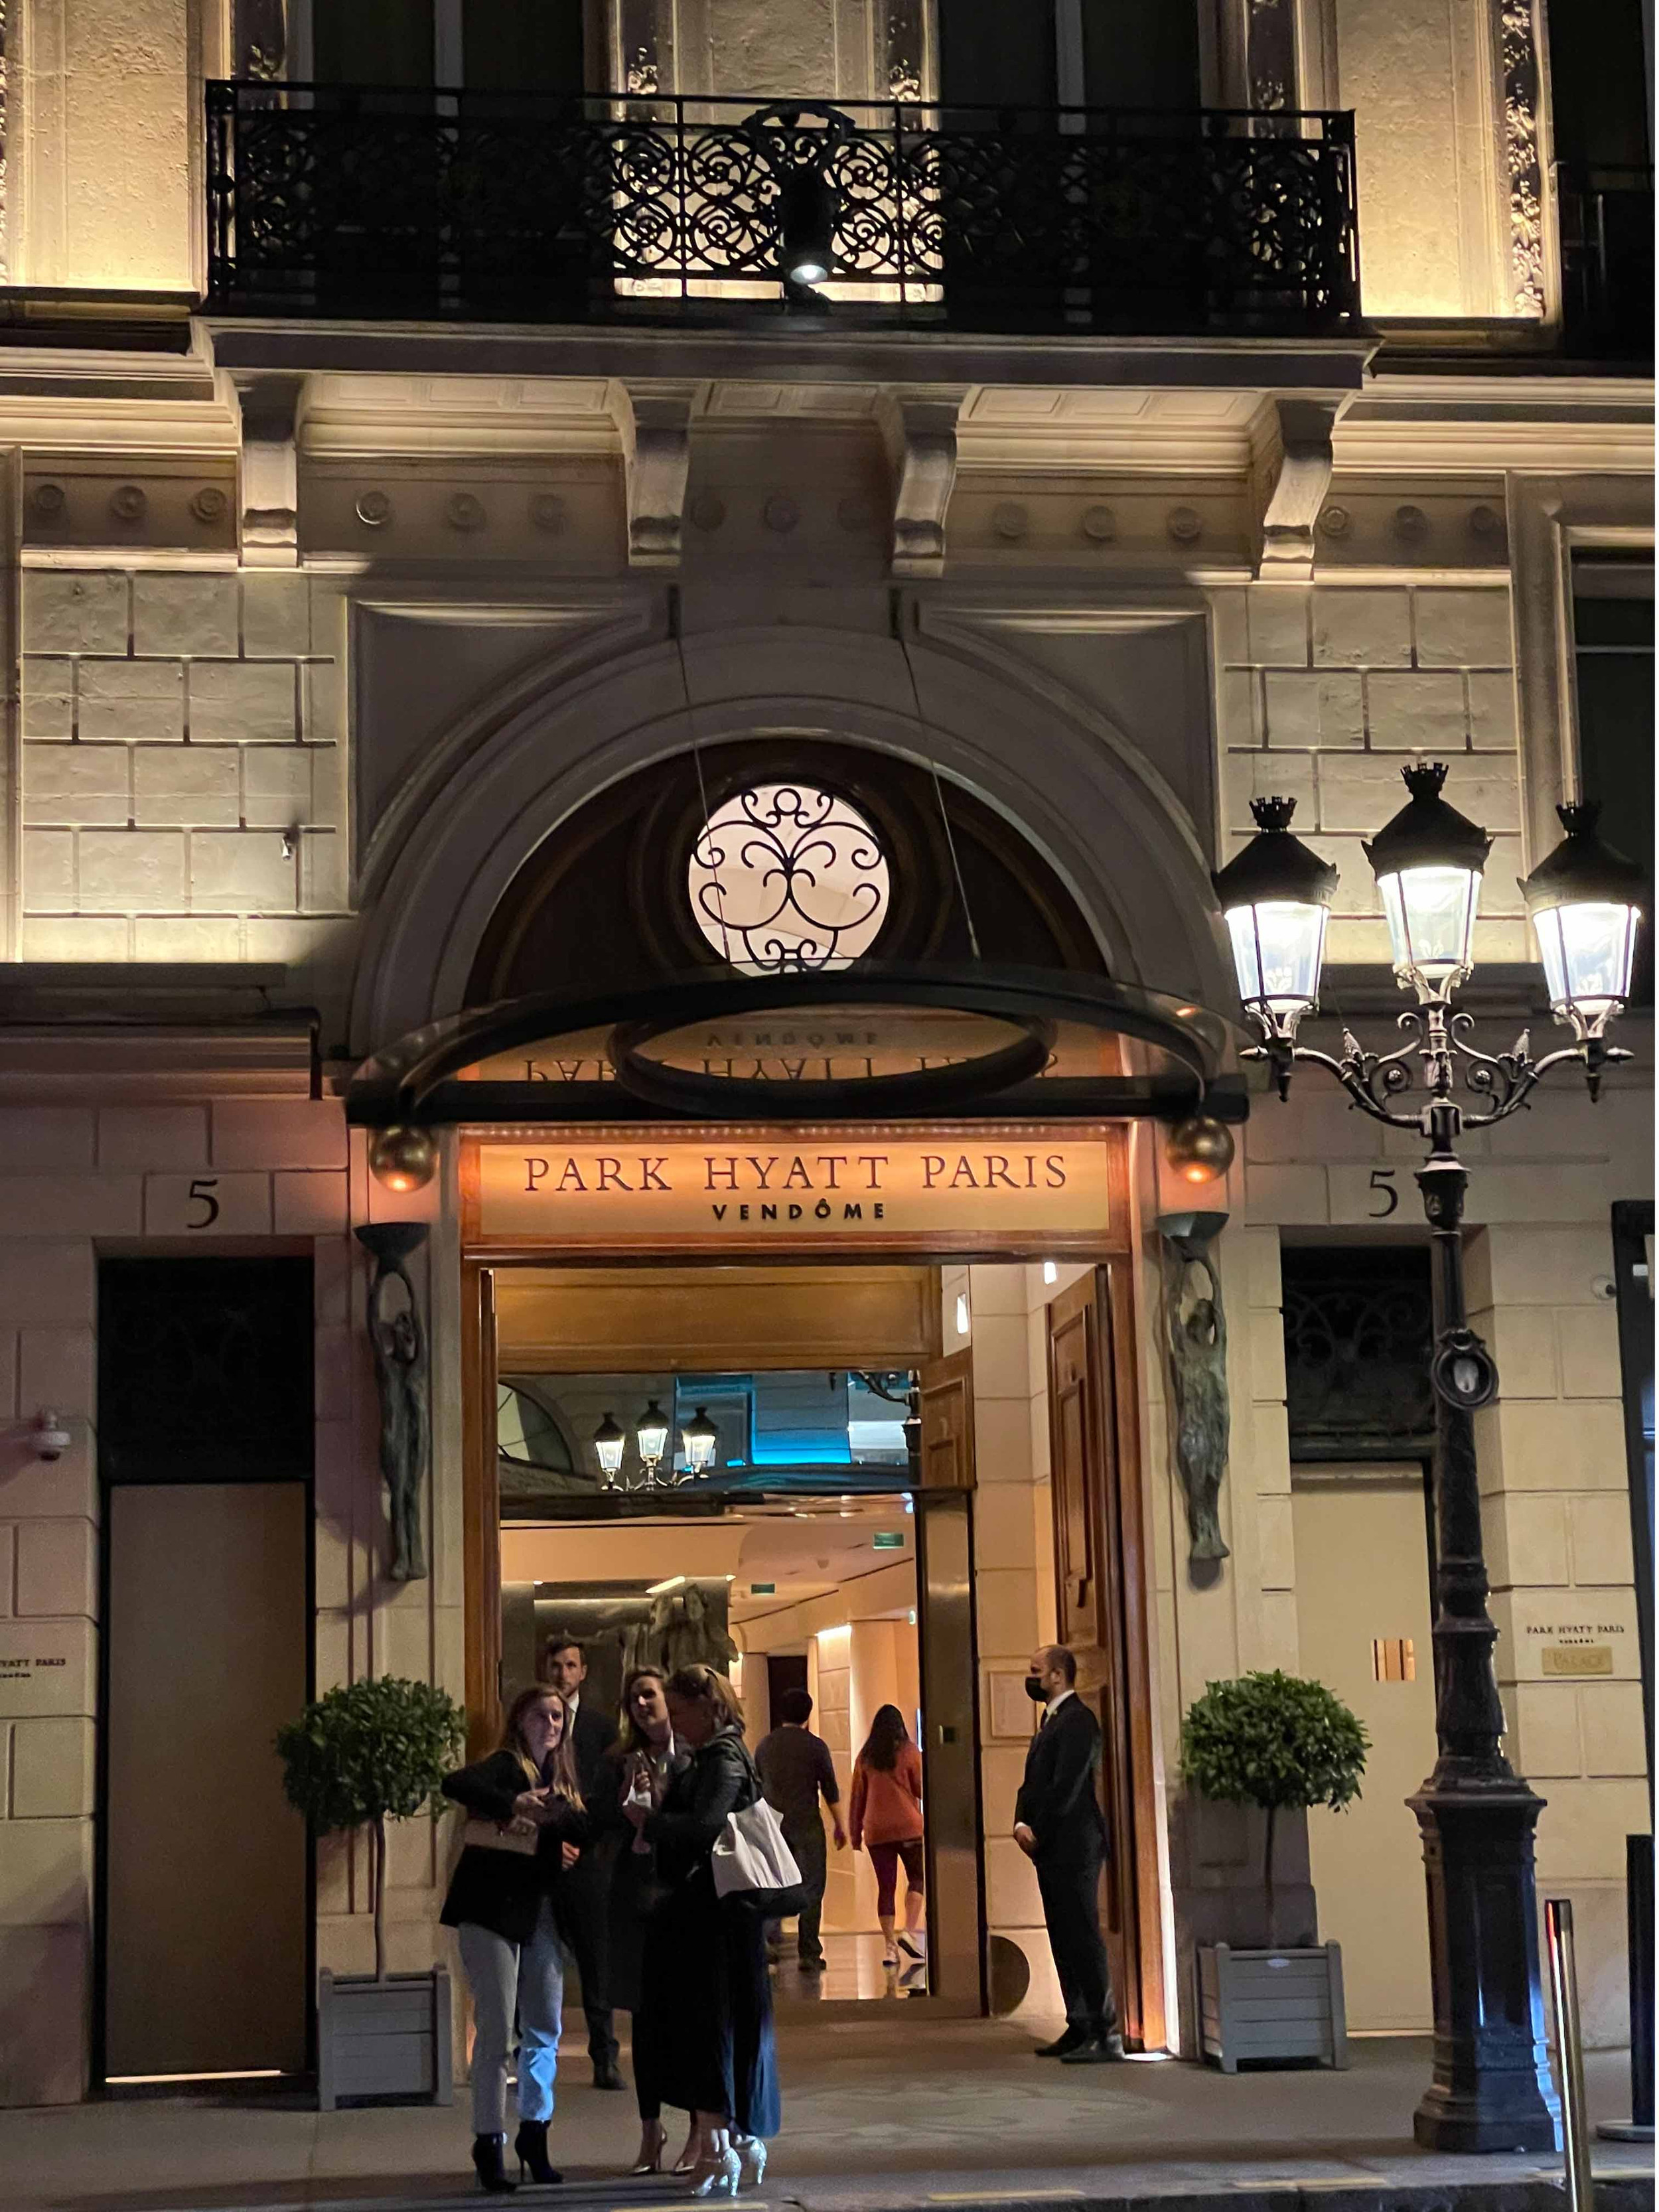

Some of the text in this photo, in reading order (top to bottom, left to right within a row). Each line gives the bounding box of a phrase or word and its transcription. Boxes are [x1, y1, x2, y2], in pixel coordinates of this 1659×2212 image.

[524, 1155, 1066, 1191] PARK HYATT PARIS
[187, 1179, 219, 1228] 5
[712, 1198, 883, 1220] VENDÔME
[1369, 1169, 1398, 1217] 5
[36, 1658, 66, 1666] PARIS
